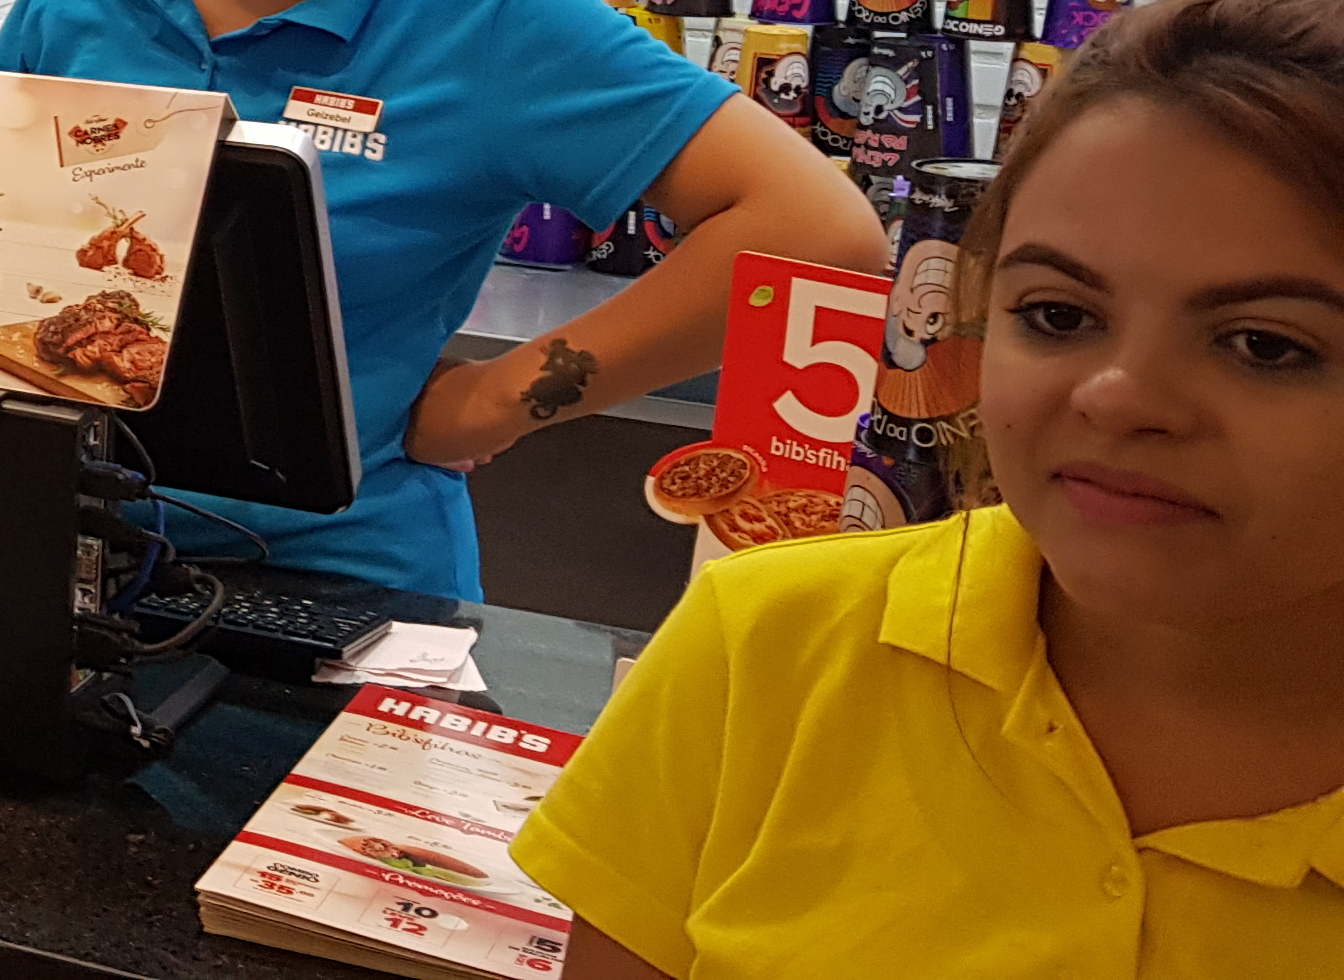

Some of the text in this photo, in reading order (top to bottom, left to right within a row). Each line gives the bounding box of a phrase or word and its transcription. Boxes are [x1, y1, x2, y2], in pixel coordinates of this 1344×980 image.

[74, 122, 120, 138] CARNES
[72, 157, 146, 183] Experimente
[773, 276, 889, 444] 5
[886, 423, 908, 441] DO
[377, 697, 553, 755] HABIB'S
[395, 898, 440, 920] 10
[385, 916, 429, 937] 12
